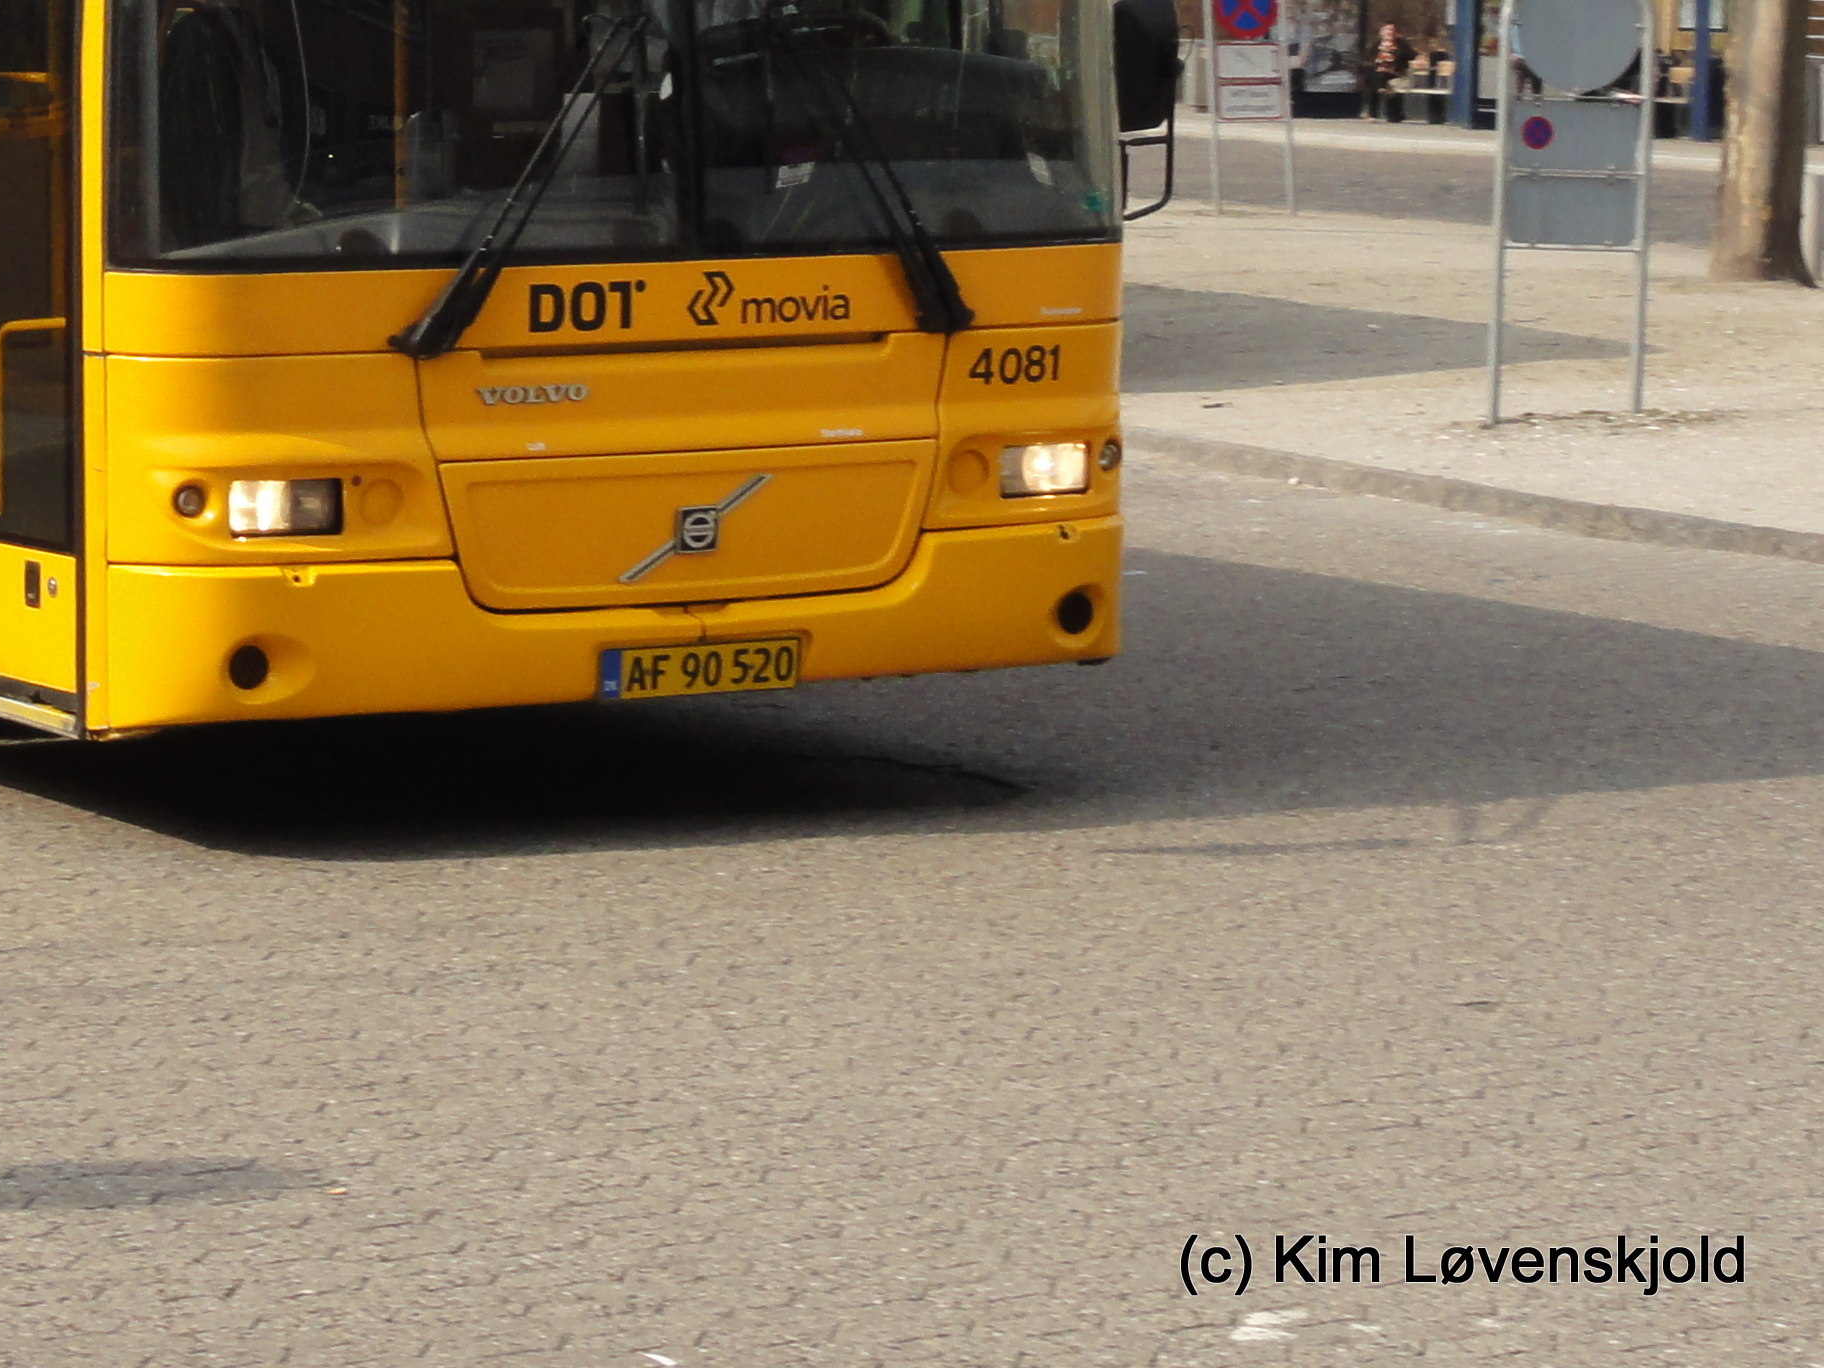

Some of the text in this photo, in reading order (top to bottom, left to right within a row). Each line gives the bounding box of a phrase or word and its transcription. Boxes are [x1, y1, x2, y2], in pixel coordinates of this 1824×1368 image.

[529, 280, 646, 334] DOT
[740, 284, 852, 326] movia
[969, 344, 1063, 387] 4081
[475, 383, 589, 406] VOLVO
[626, 645, 795, 692] AF 90 520
